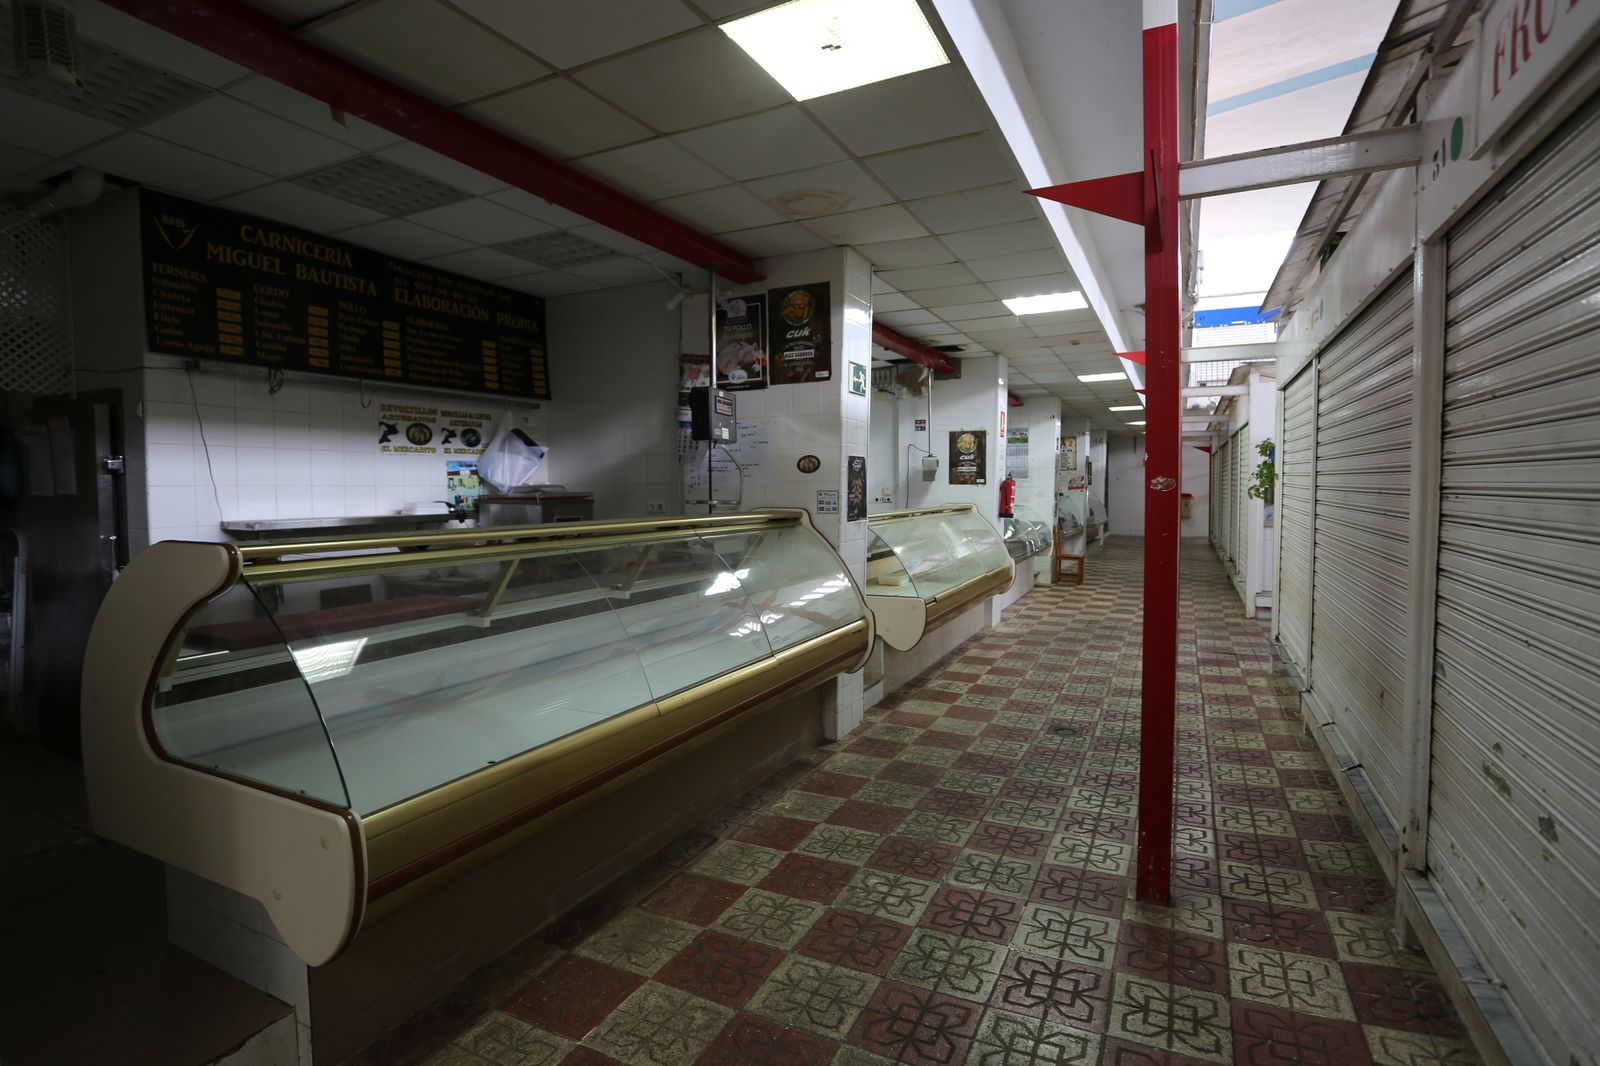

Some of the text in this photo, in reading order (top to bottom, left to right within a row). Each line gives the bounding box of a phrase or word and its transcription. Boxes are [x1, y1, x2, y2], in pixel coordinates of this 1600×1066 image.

[1490, 0, 1582, 101] FRU
[206, 240, 287, 276] MIGUEL
[295, 263, 378, 297] BAUTISTA
[240, 224, 354, 269] CARNICERÍA
[151, 262, 208, 283] TERNERA
[394, 287, 539, 333] ELABORACIÓN PROPIA
